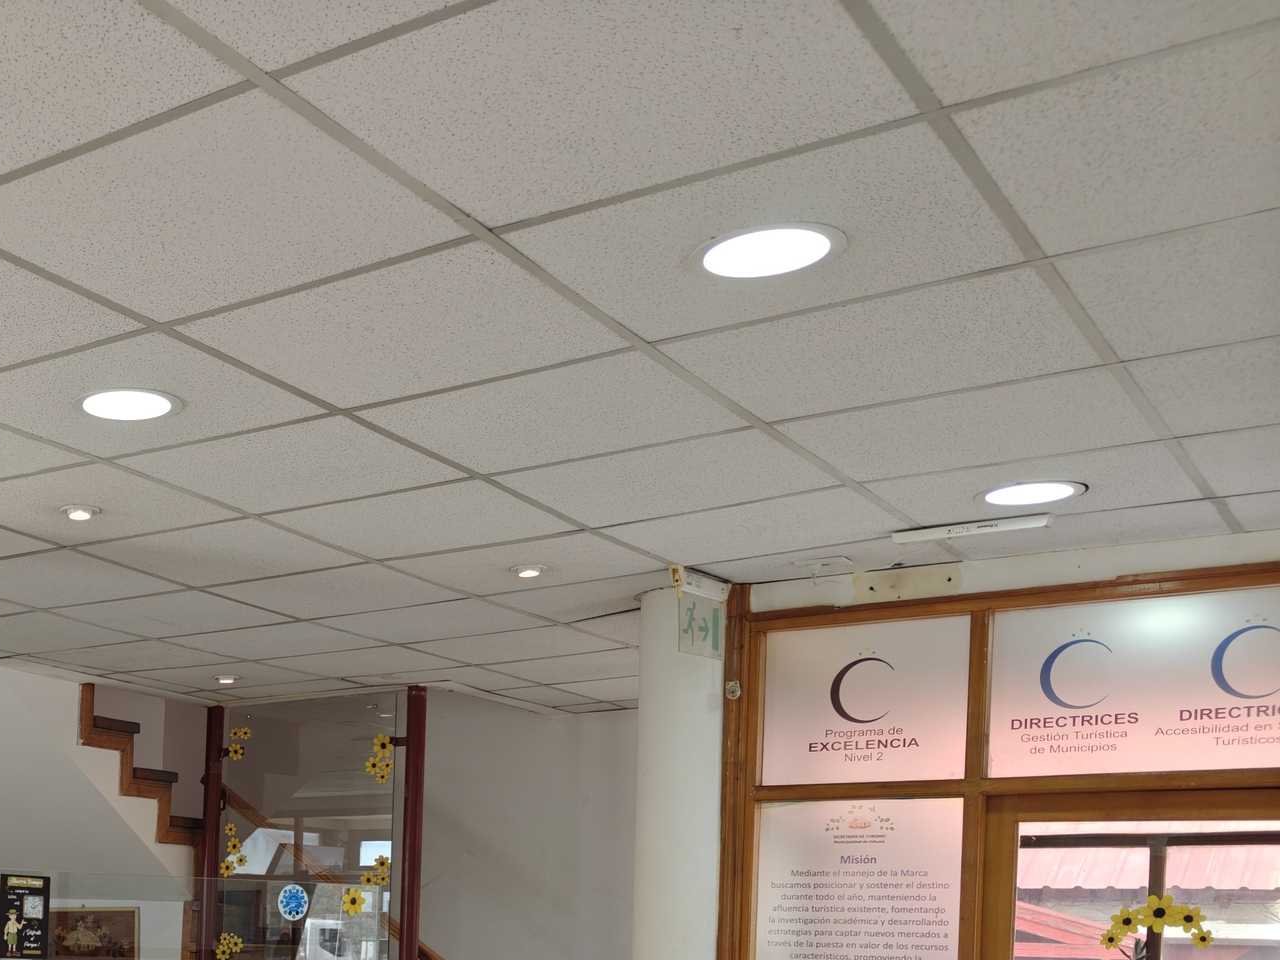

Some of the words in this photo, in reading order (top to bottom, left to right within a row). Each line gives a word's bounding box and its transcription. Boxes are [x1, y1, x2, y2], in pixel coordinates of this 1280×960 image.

[1010, 712, 1139, 730] DIRECTRICES
[825, 726, 884, 738] Programa
[888, 725, 904, 736] de
[1020, 730, 1071, 744] Gestión
[1074, 728, 1128, 740] Turística
[1154, 723, 1248, 736] Accesibilidad
[1254, 724, 1272, 732] en
[808, 736, 920, 752] EXCELENCIA
[1029, 744, 1046, 754] de
[1048, 741, 1117, 755] Municipios
[844, 751, 872, 762] Nivel
[876, 750, 884, 761] 2
[840, 854, 876, 864] Misión
[790, 868, 830, 877] Mediante
[832, 868, 840, 877] el
[842, 871, 874, 880] manejo
[876, 868, 887, 877] de
[890, 868, 897, 877] la
[900, 868, 927, 877] Marca
[770, 880, 811, 889] buscamos
[813, 880, 856, 892] posicionar
[858, 883, 864, 892] y
[866, 880, 903, 889] sostener
[905, 880, 913, 889] el
[916, 880, 949, 889] destino
[781, 892, 813, 901] durante
[815, 892, 834, 901] todo
[837, 892, 844, 901] el
[846, 892, 865, 902] año,
[867, 892, 926, 901] manteniendo
[929, 893, 936, 902] la
[772, 904, 808, 913] afluencia
[811, 904, 844, 913] turística
[847, 904, 889, 914] existente,
[891, 904, 945, 914] fomentando
[768, 915, 775, 924] la
[777, 915, 830, 927] investigación
[832, 916, 877, 925] académica
[880, 919, 885, 928] y
[887, 916, 949, 926] desarrollando
[768, 927, 811, 939] estrategias
[814, 930, 832, 939] para
[834, 928, 861, 940] captar
[897, 930, 940, 938] mercados
